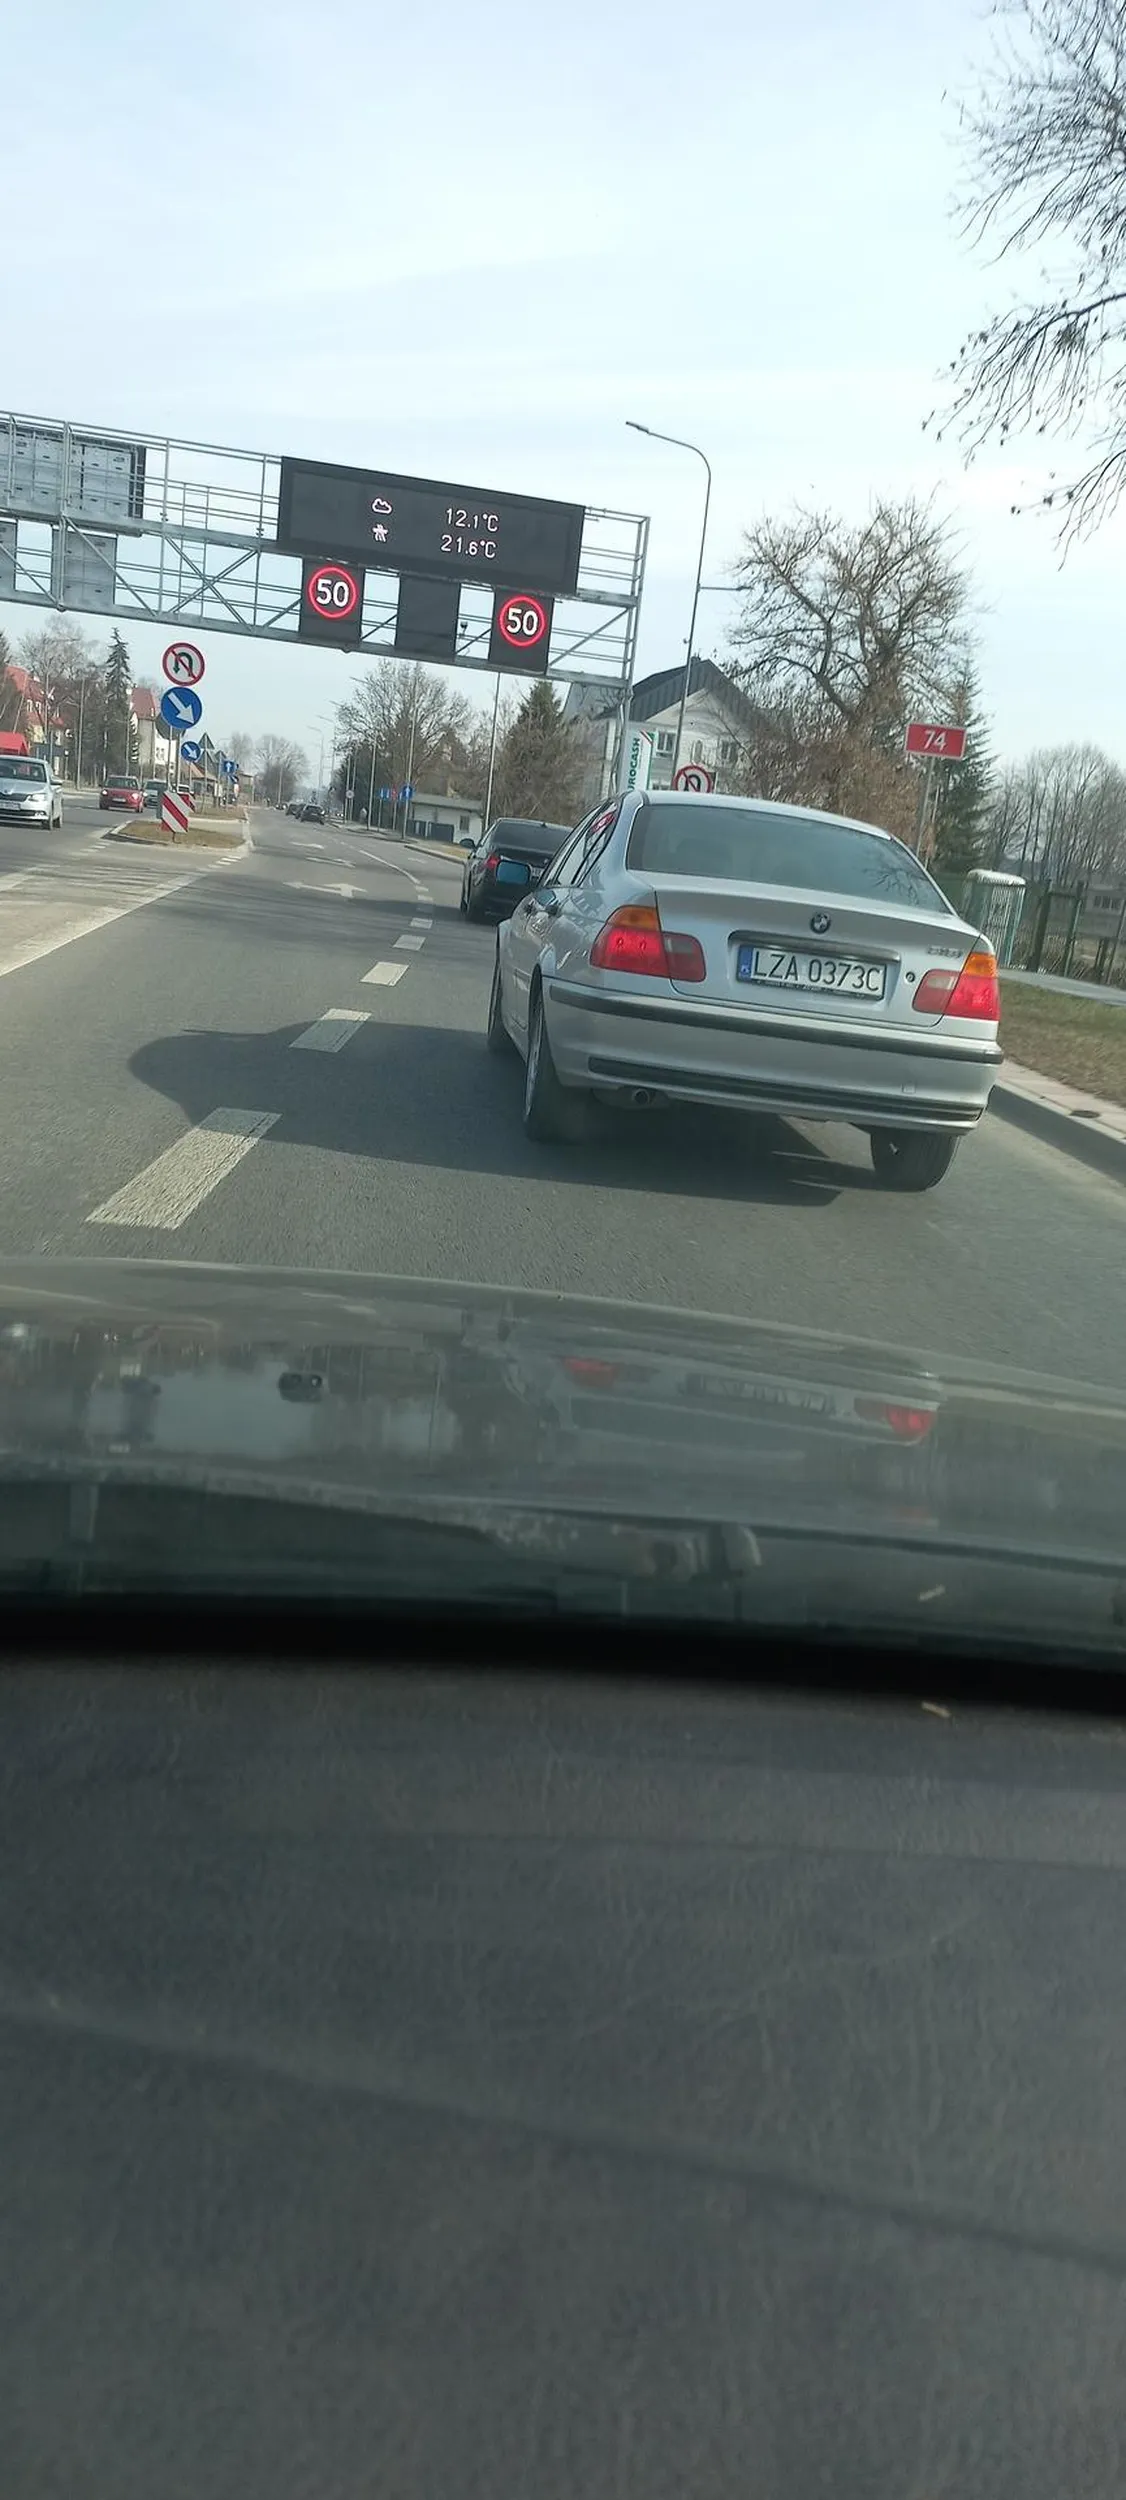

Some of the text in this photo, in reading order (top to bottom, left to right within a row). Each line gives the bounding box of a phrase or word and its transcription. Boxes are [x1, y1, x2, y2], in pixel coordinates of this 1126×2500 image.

[446, 508, 499, 532] 12.1°C
[440, 534, 497, 558] 21.6°C
[315, 578, 350, 608] 50
[506, 607, 539, 636] 50
[923, 729, 947, 751] 74
[754, 951, 799, 982] LZA
[808, 958, 880, 991] 0373C
